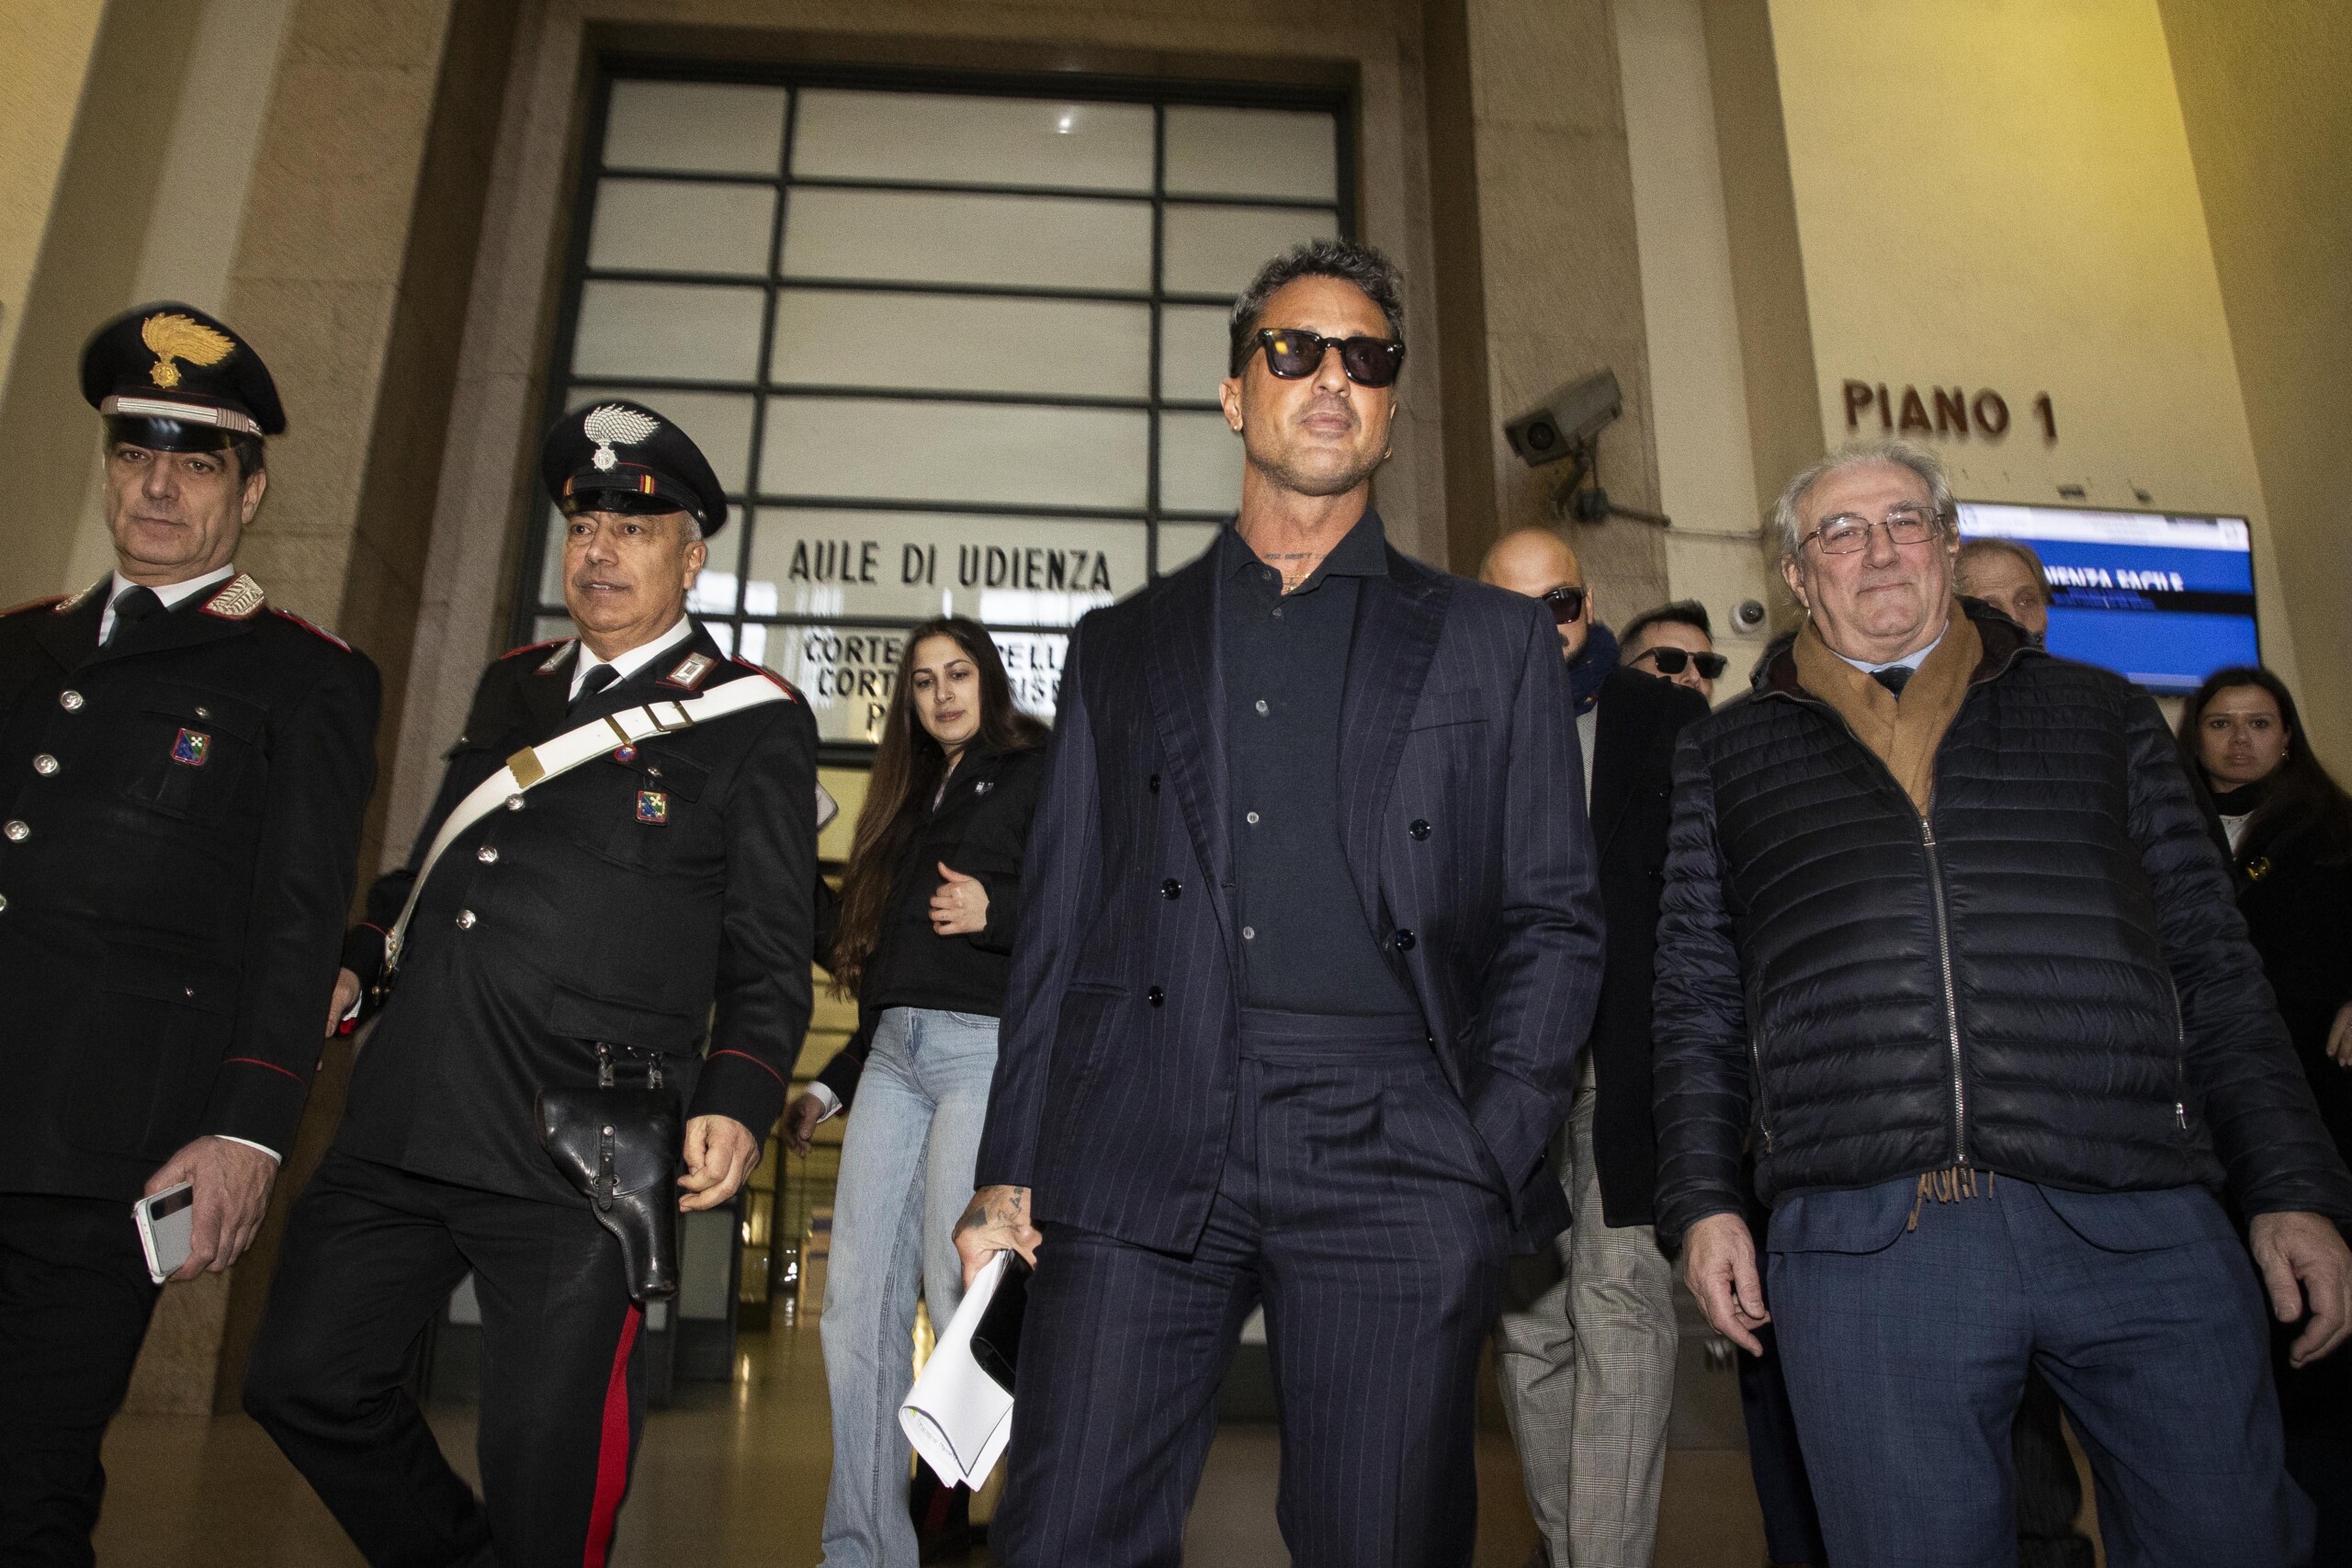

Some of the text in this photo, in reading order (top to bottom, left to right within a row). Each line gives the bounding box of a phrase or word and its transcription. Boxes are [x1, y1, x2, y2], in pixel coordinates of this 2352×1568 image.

[1842, 378, 2058, 447] PIANO 1
[788, 538, 1113, 592] AULE DI UDIENZA
[805, 634, 901, 663] CORTE
[818, 667, 897, 697] CORT
[866, 702, 887, 732] P
